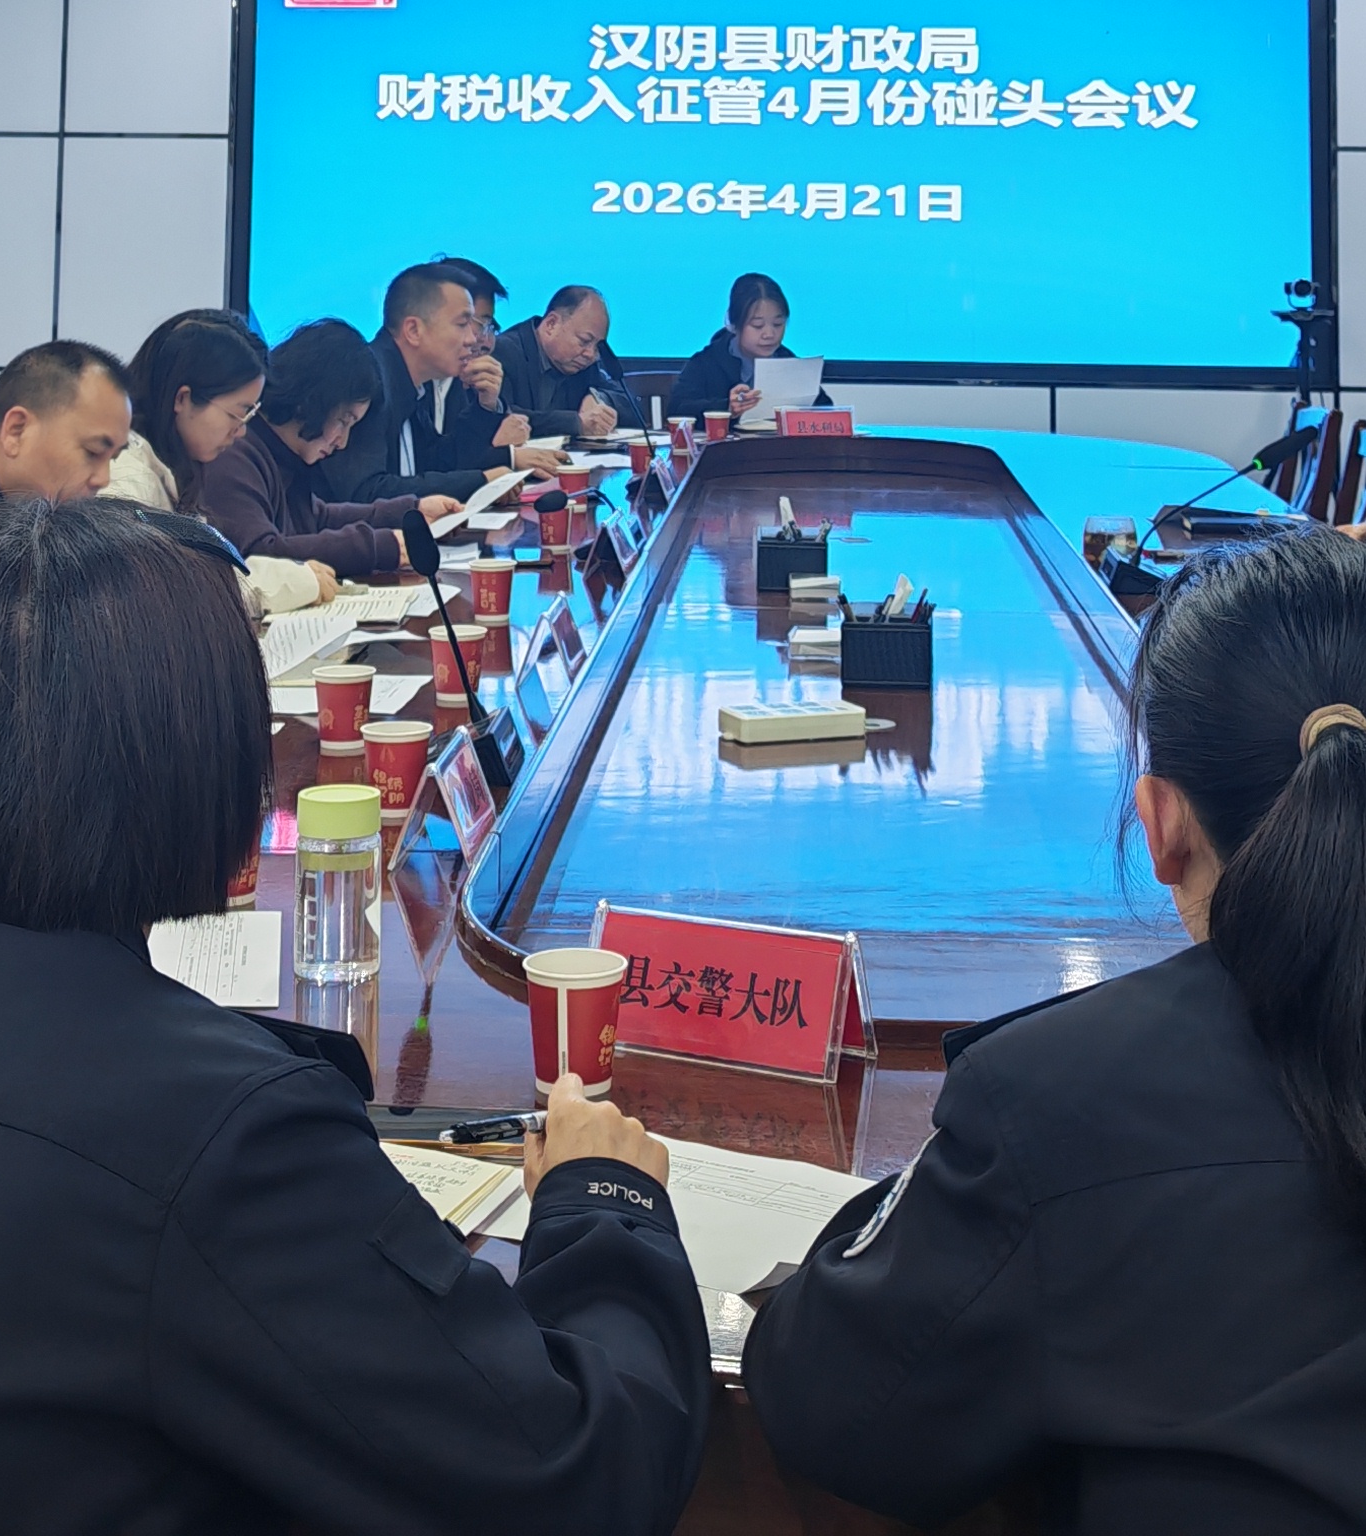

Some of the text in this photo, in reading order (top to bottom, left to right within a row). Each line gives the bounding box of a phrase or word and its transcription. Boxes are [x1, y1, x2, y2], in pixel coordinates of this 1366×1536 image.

[588, 23, 979, 74] 汉阴县财政局
[376, 73, 1198, 129] 财税收入征管4月份碰头会议
[591, 180, 963, 221] 2026年4月21日
[619, 954, 808, 1029] 县交警大队
[587, 1181, 653, 1210] POLICE
